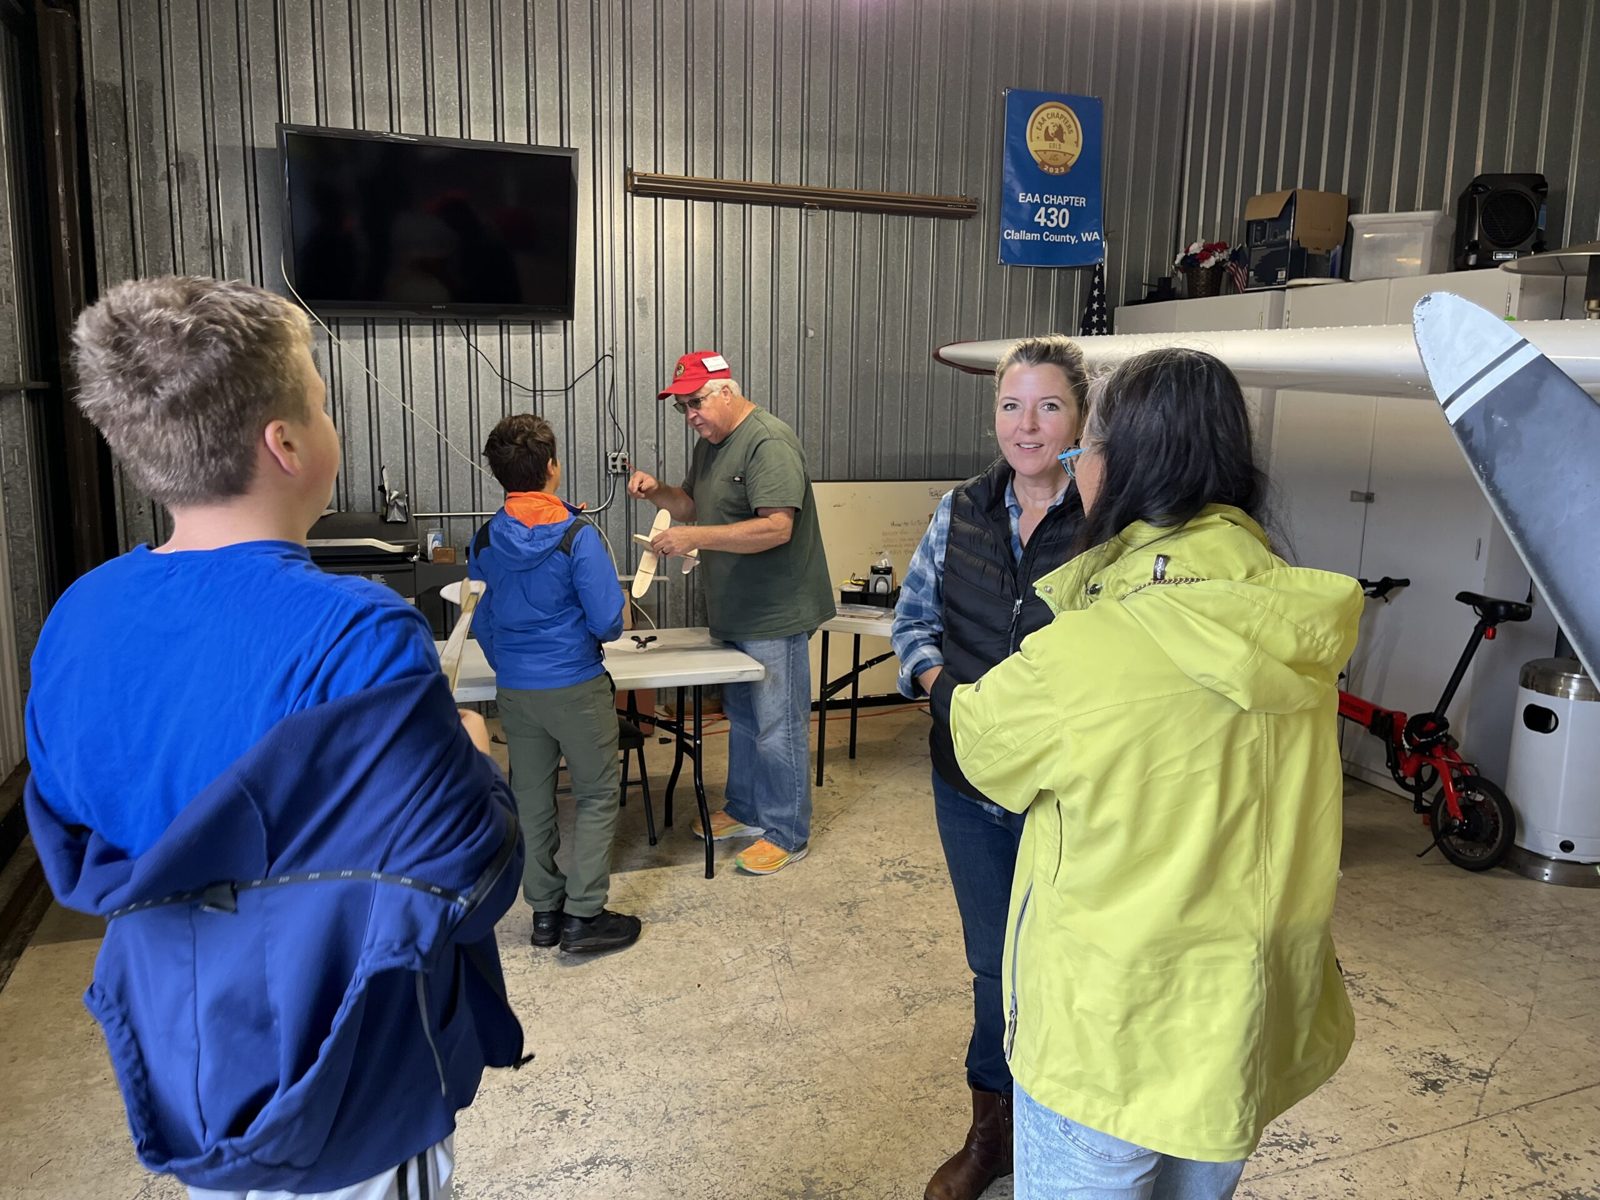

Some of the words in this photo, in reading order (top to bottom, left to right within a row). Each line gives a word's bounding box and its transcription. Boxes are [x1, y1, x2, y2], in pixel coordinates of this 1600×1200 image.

[1036, 116, 1047, 131] EAA
[1046, 112, 1073, 134] CHAPTERS
[1018, 193, 1040, 204] EAA
[1043, 194, 1086, 207] CHAPTER
[1034, 207, 1070, 228] 430
[1004, 230, 1040, 241] Clallam
[1043, 232, 1079, 244] County,
[1081, 231, 1100, 242] WA
